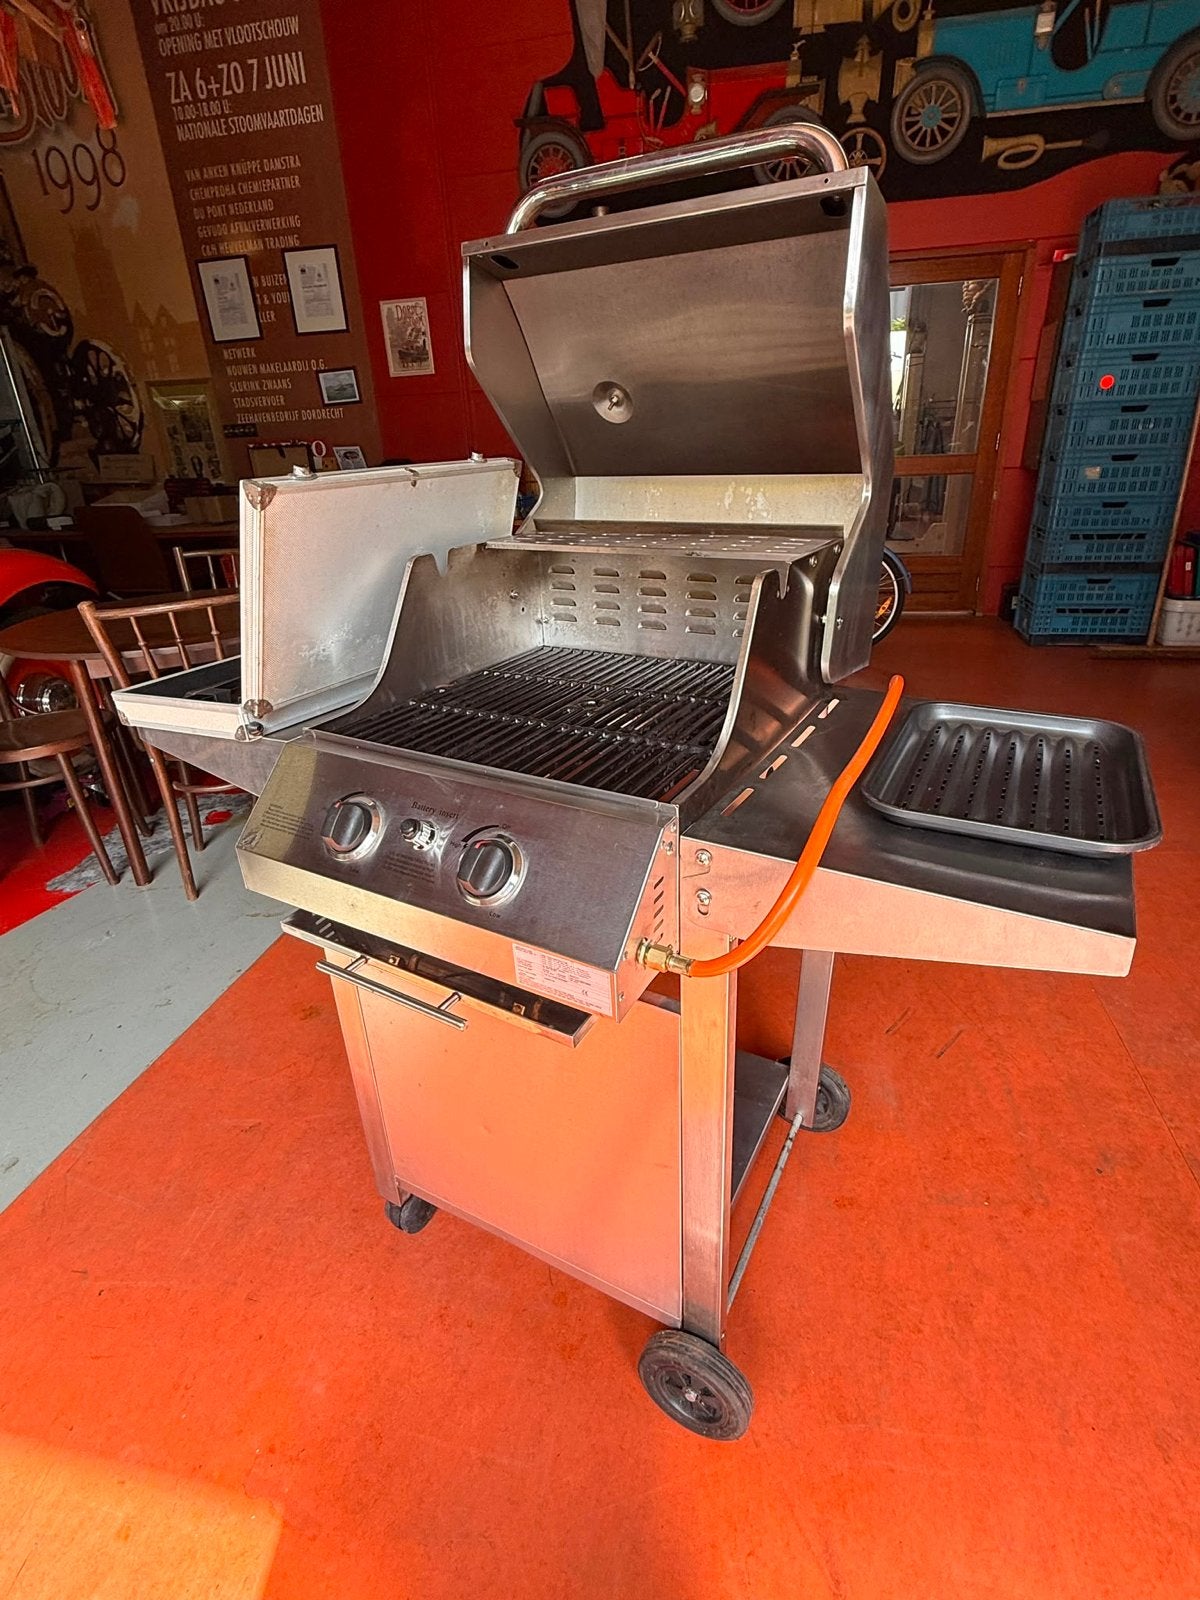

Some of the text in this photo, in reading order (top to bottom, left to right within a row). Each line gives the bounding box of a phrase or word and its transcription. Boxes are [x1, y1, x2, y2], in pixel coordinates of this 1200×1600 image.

[159, 15, 299, 56] OPENING MET VLOOTSCHOUW
[166, 70, 193, 104] ZA
[247, 58, 258, 92] 7
[264, 51, 307, 90] JUNI
[176, 104, 324, 142] NATIONALE STOOMVAARTDAGEN
[32, 126, 126, 214] 1998
[184, 169, 201, 182] VAN
[263, 154, 301, 172] DAMSTRA
[238, 175, 301, 195] CHEMIEPARTNER
[207, 204, 227, 218] PONT
[228, 199, 274, 215] NEDERLAND
[230, 215, 301, 234] AFVALVERWERKING
[264, 234, 300, 250] TRADING
[223, 347, 257, 360] NETWERK
[259, 360, 309, 375] MAKELAARDIJ
[310, 358, 328, 371] O.G.
[262, 378, 292, 391] ZWAANS
[233, 395, 285, 408] STADSVERVOER
[236, 408, 344, 424] ZEEHAVENBEDRIJF DORDRECHT
[411, 801, 460, 820] Battery insert
